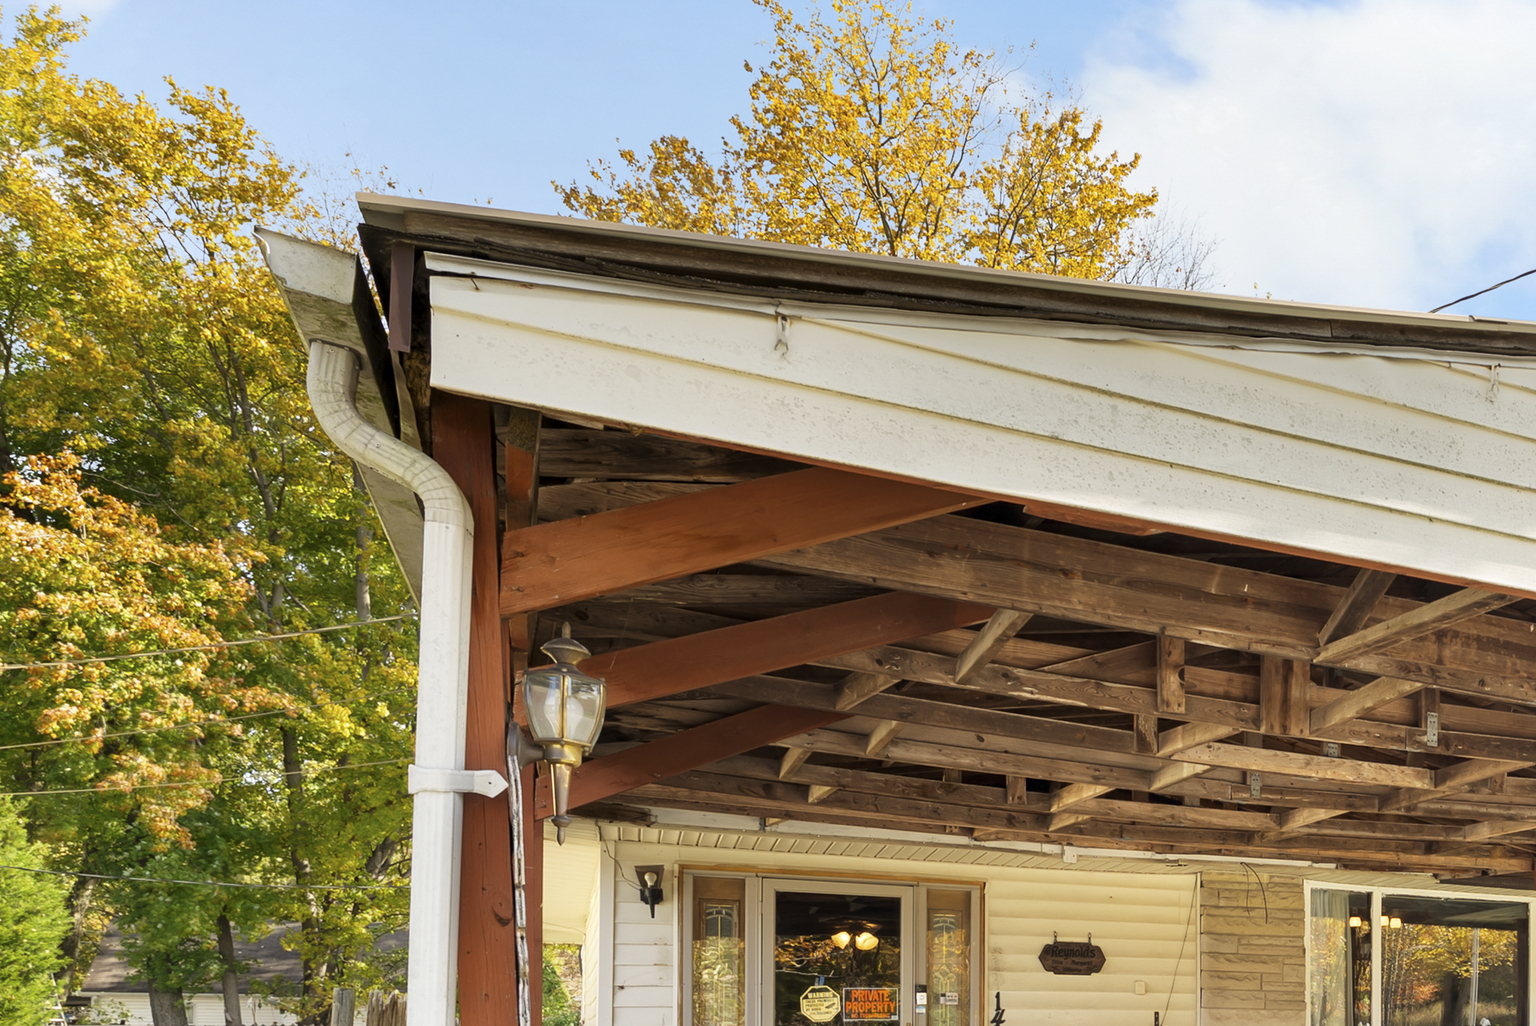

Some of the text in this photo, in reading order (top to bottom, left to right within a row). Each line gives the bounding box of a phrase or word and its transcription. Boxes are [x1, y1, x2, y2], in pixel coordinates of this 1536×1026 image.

[1051, 945, 1096, 960] Reynolds
[851, 989, 890, 1001] PRIVATE
[846, 1001, 896, 1013] PROPERTY
